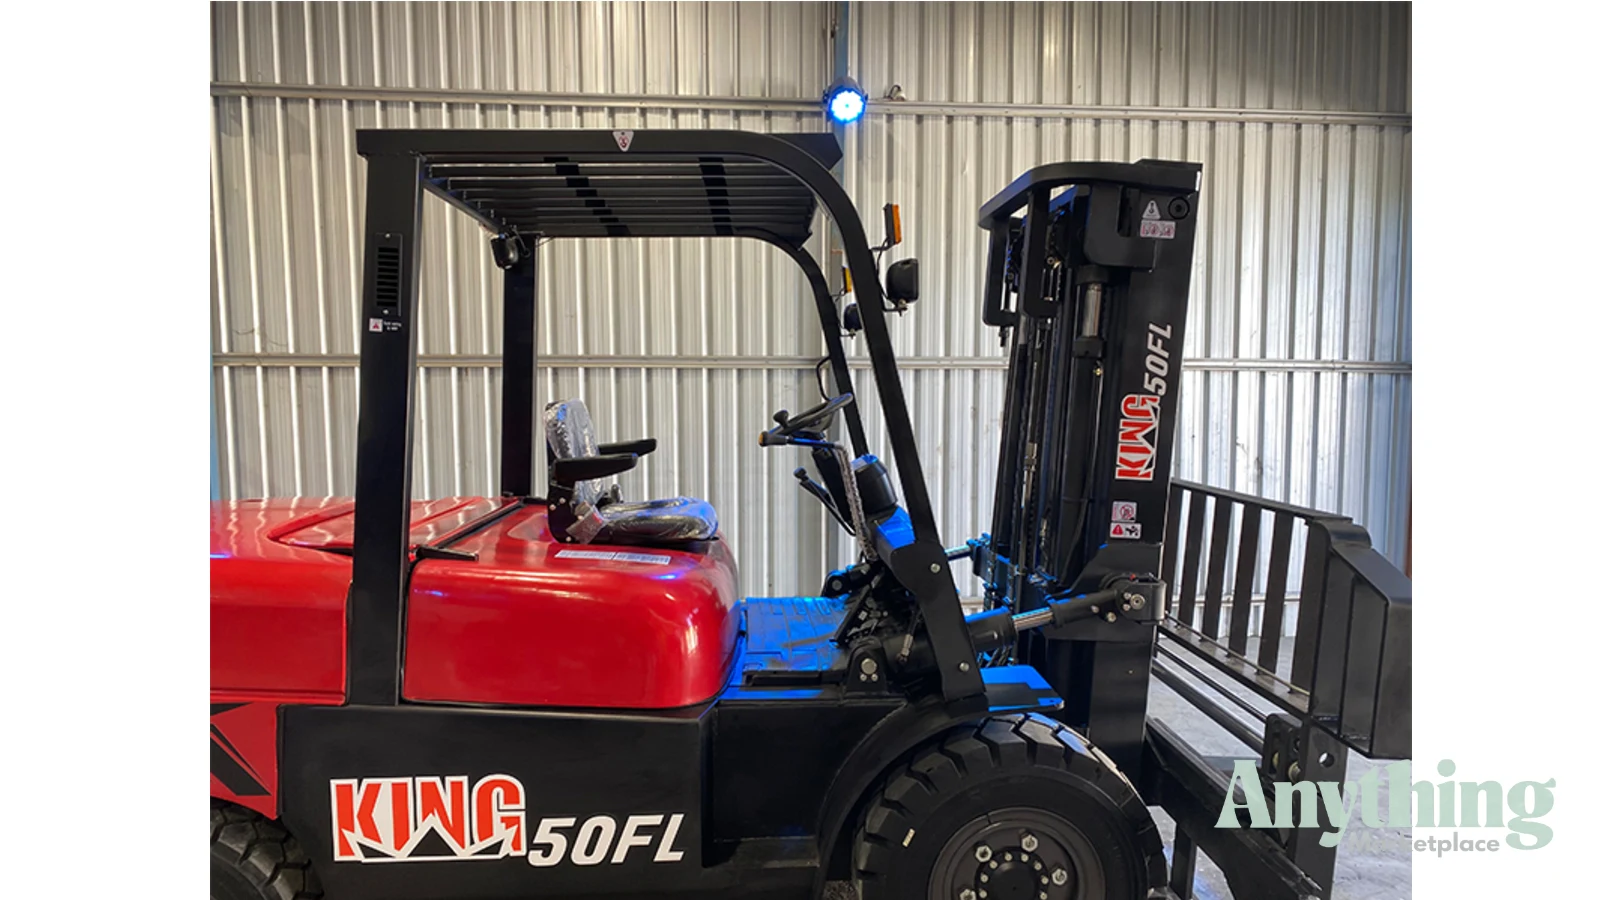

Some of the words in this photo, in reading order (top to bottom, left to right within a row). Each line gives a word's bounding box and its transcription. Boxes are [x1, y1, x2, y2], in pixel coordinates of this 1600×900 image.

[1115, 394, 1160, 481] KING
[1143, 323, 1173, 396] 50FL
[330, 774, 526, 863] KING
[527, 814, 685, 867] 50FL
